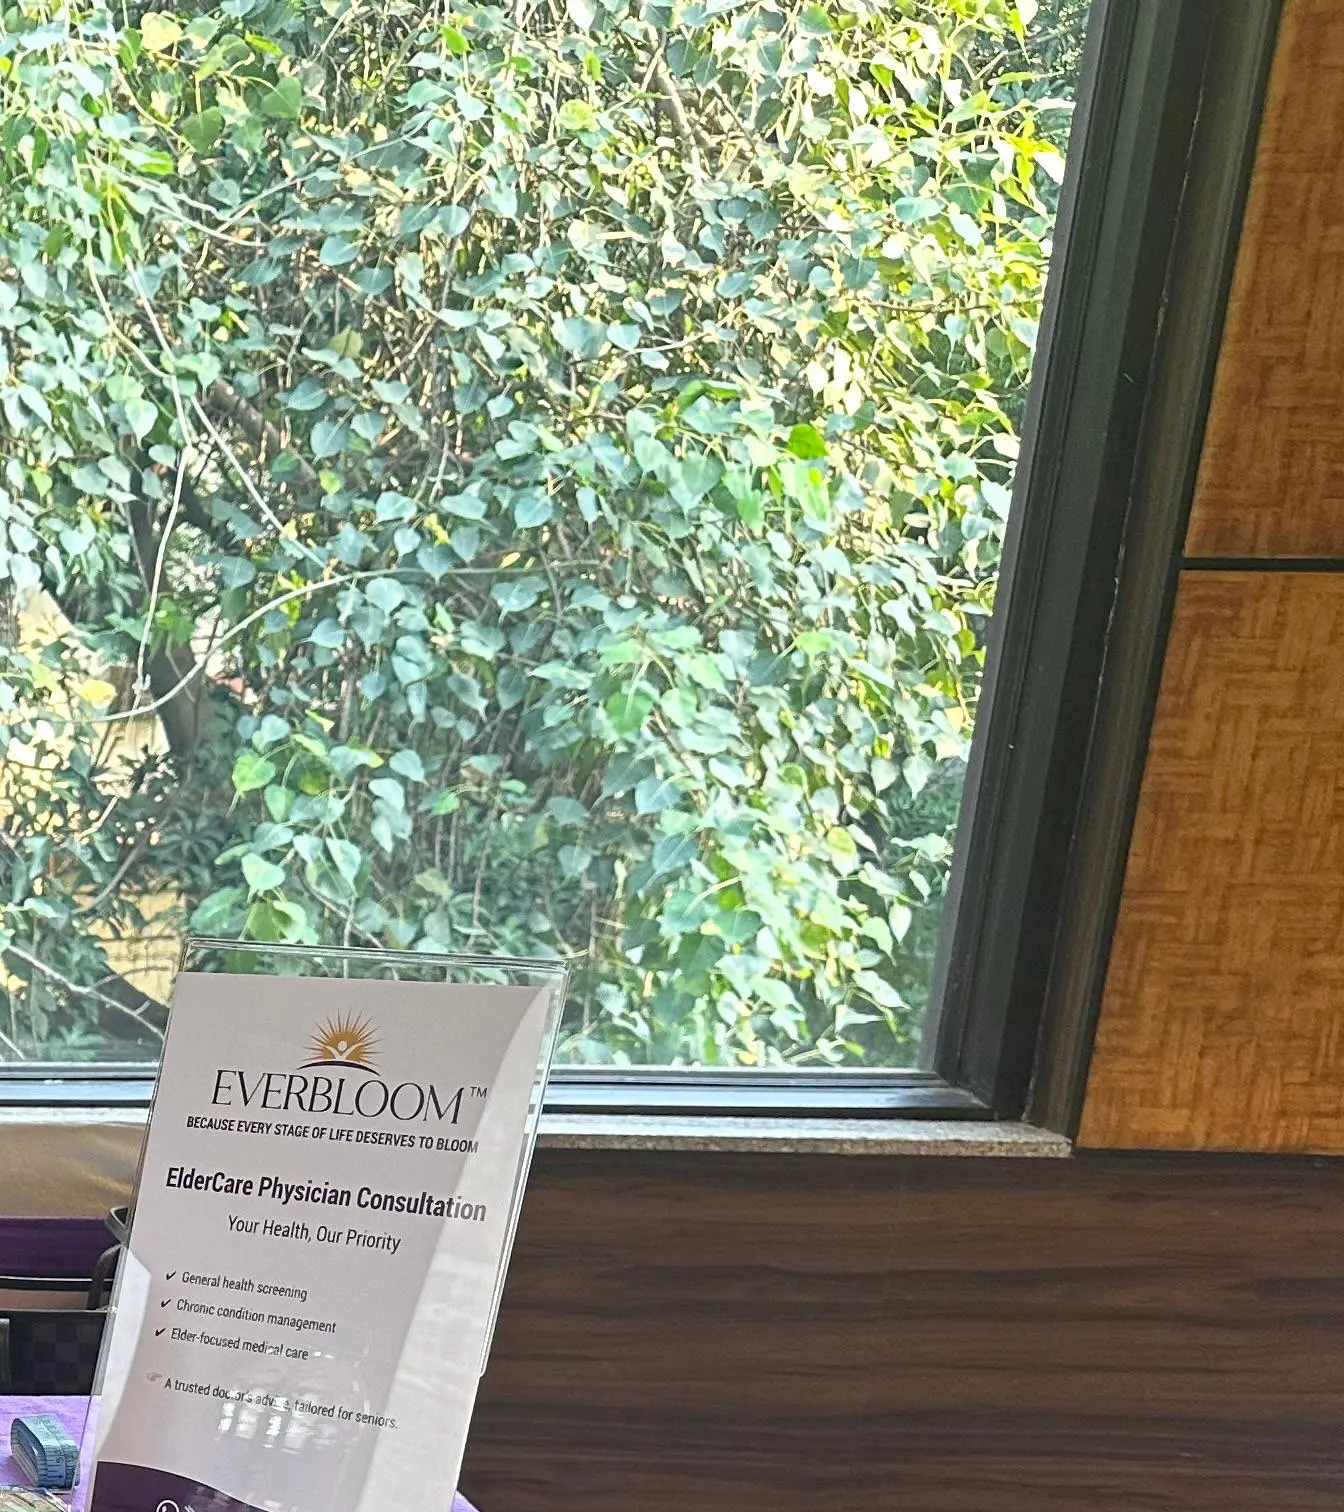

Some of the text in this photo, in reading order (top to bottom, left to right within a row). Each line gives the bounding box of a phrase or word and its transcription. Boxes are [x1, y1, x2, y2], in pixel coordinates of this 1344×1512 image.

[187, 1116, 478, 1153] BECAUSE EVERY STAGE OF LIFE DESERVES TO BLOOM
[166, 1167, 486, 1221] ElderCare Physician Consultation
[229, 1215, 401, 1254] Your Health, Our Priority
[182, 1272, 307, 1302] General health screening
[177, 1299, 336, 1333] Chronic condition management
[171, 1328, 308, 1360] Elder-focused medical care
[165, 1378, 397, 1429] A trusted tailored for seniors.
